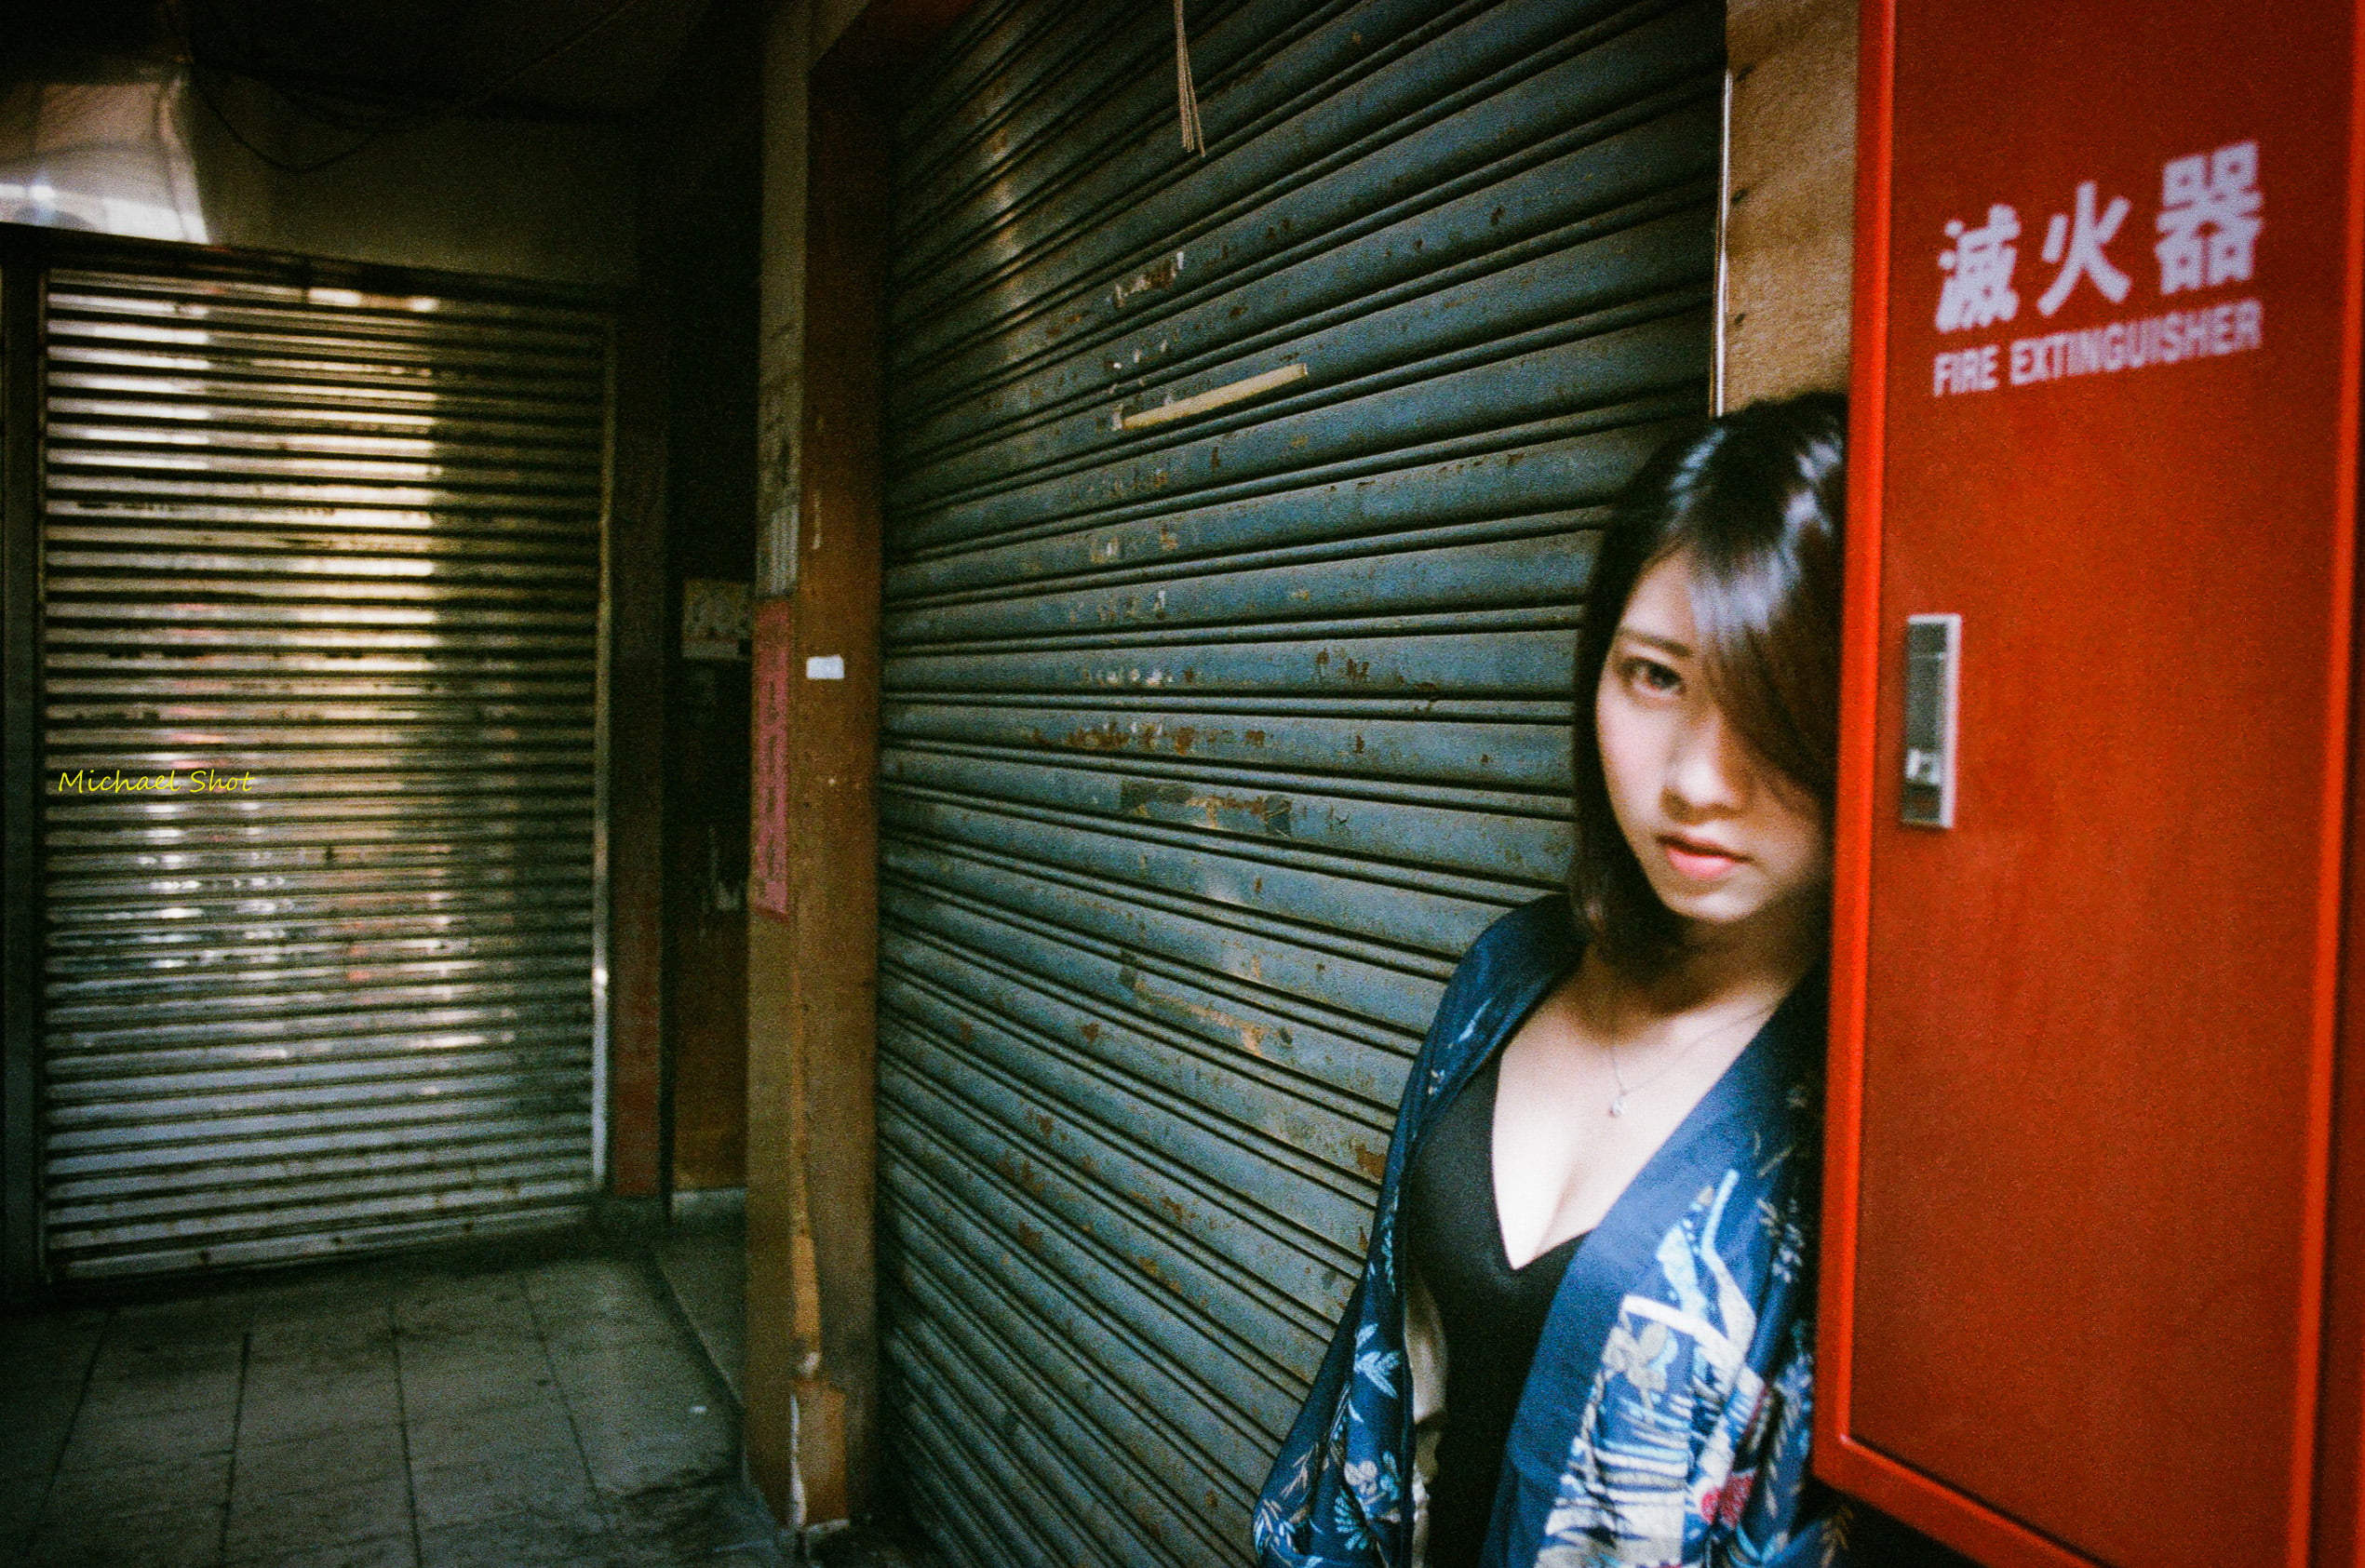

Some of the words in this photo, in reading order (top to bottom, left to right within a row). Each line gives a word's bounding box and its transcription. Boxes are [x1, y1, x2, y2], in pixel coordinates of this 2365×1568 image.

[1935, 141, 2264, 333] 滅火器
[1933, 344, 1999, 397] FIRE
[2009, 299, 2264, 385] EXTINGUISHER
